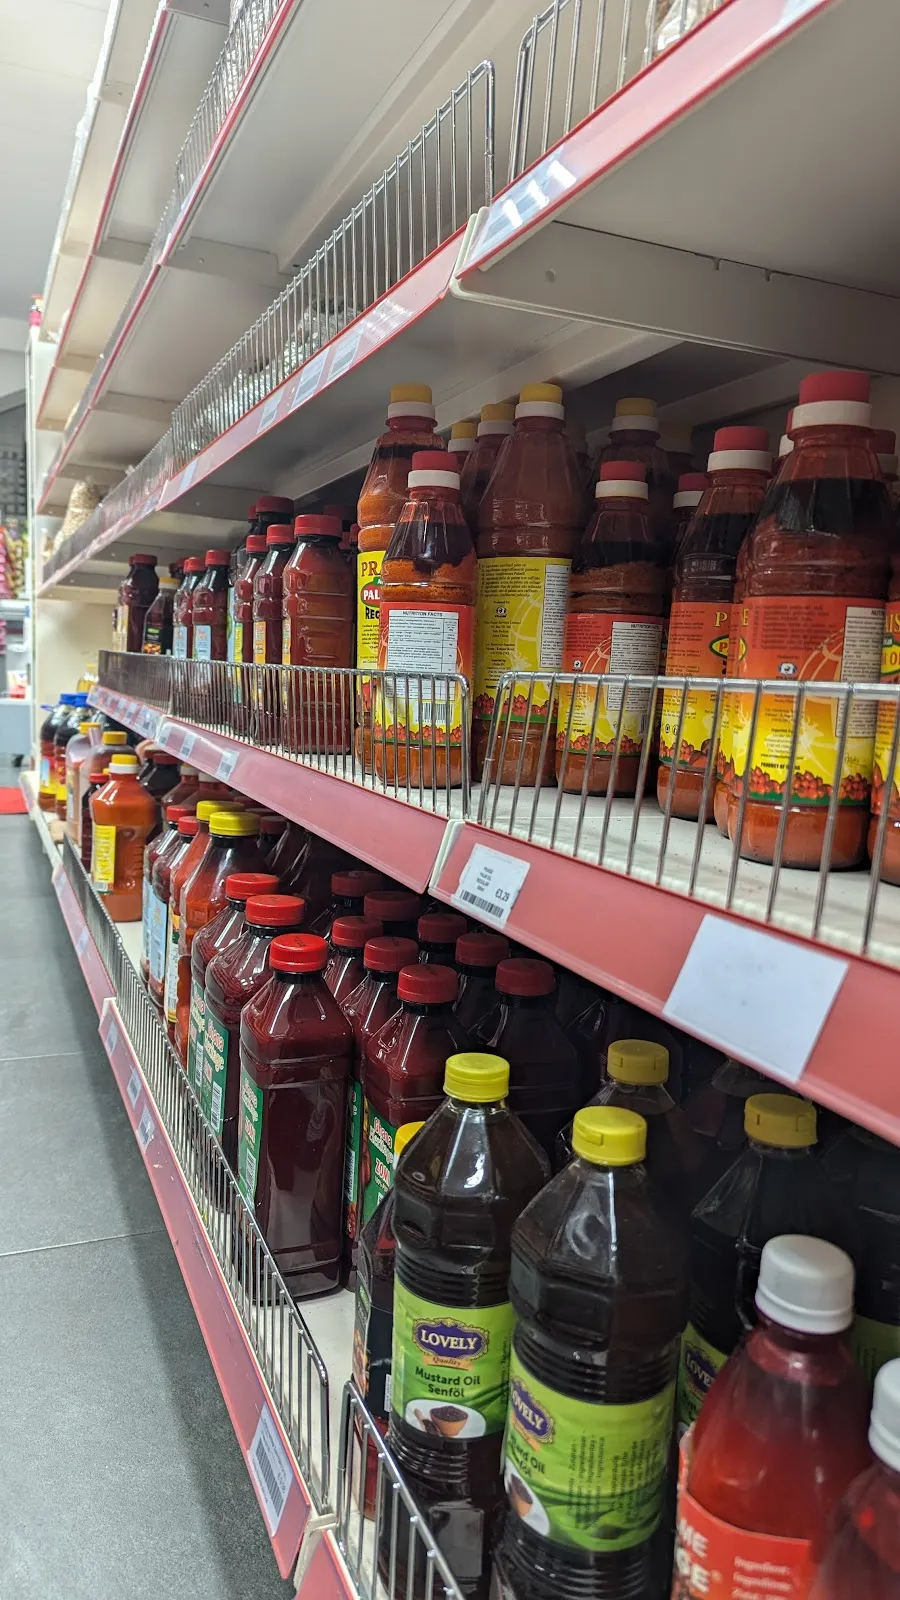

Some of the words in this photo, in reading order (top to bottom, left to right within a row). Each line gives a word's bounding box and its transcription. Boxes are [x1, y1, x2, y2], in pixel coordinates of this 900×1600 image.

[363, 589, 380, 600] PAL
[373, 1116, 393, 1149] Ghana
[421, 1329, 478, 1350] LOVELY
[432, 1356, 462, 1367] Quality
[686, 1354, 715, 1388] LOVE
[415, 1366, 461, 1386] Mustard
[463, 1375, 480, 1386] Oil
[428, 1384, 464, 1398] Senföl
[531, 1457, 546, 1475] Oil
